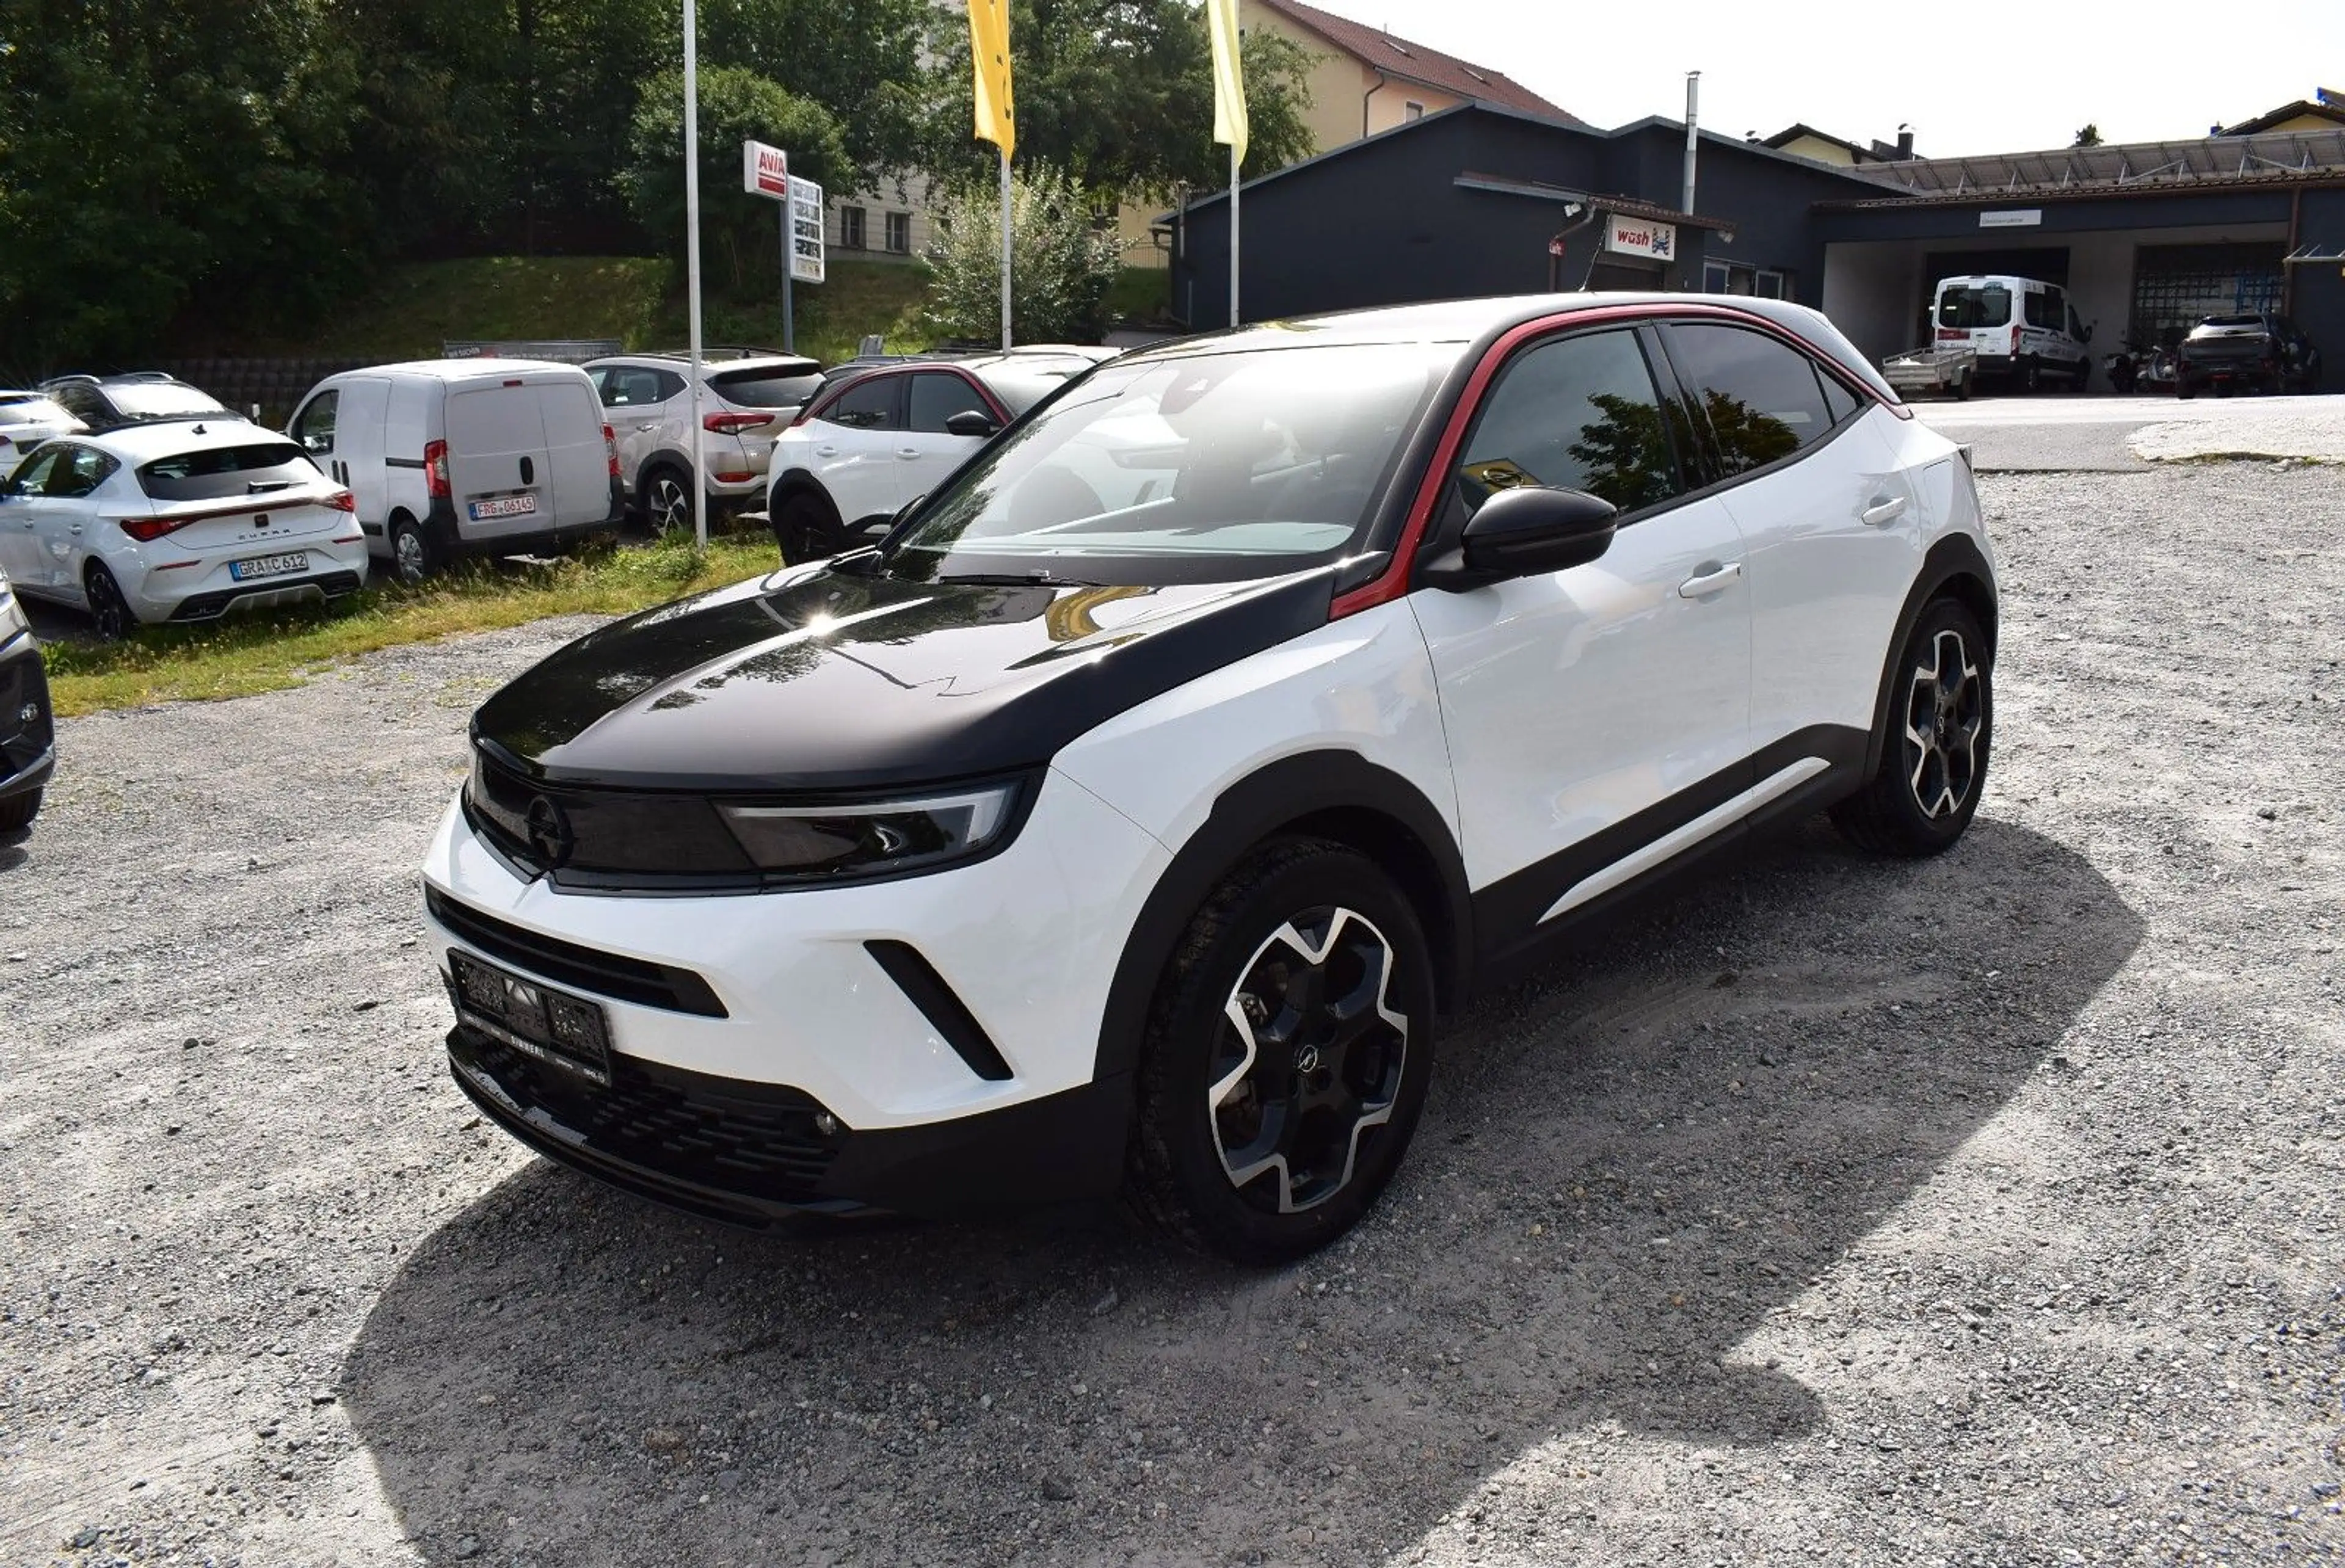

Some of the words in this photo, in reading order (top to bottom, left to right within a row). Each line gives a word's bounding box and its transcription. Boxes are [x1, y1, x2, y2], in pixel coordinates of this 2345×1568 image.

[759, 151, 785, 175] AVIA
[478, 503, 497, 516] FRG
[504, 498, 533, 512] 06145
[240, 562, 265, 575] GRA
[271, 558, 280, 570] C
[283, 553, 305, 568] 612
